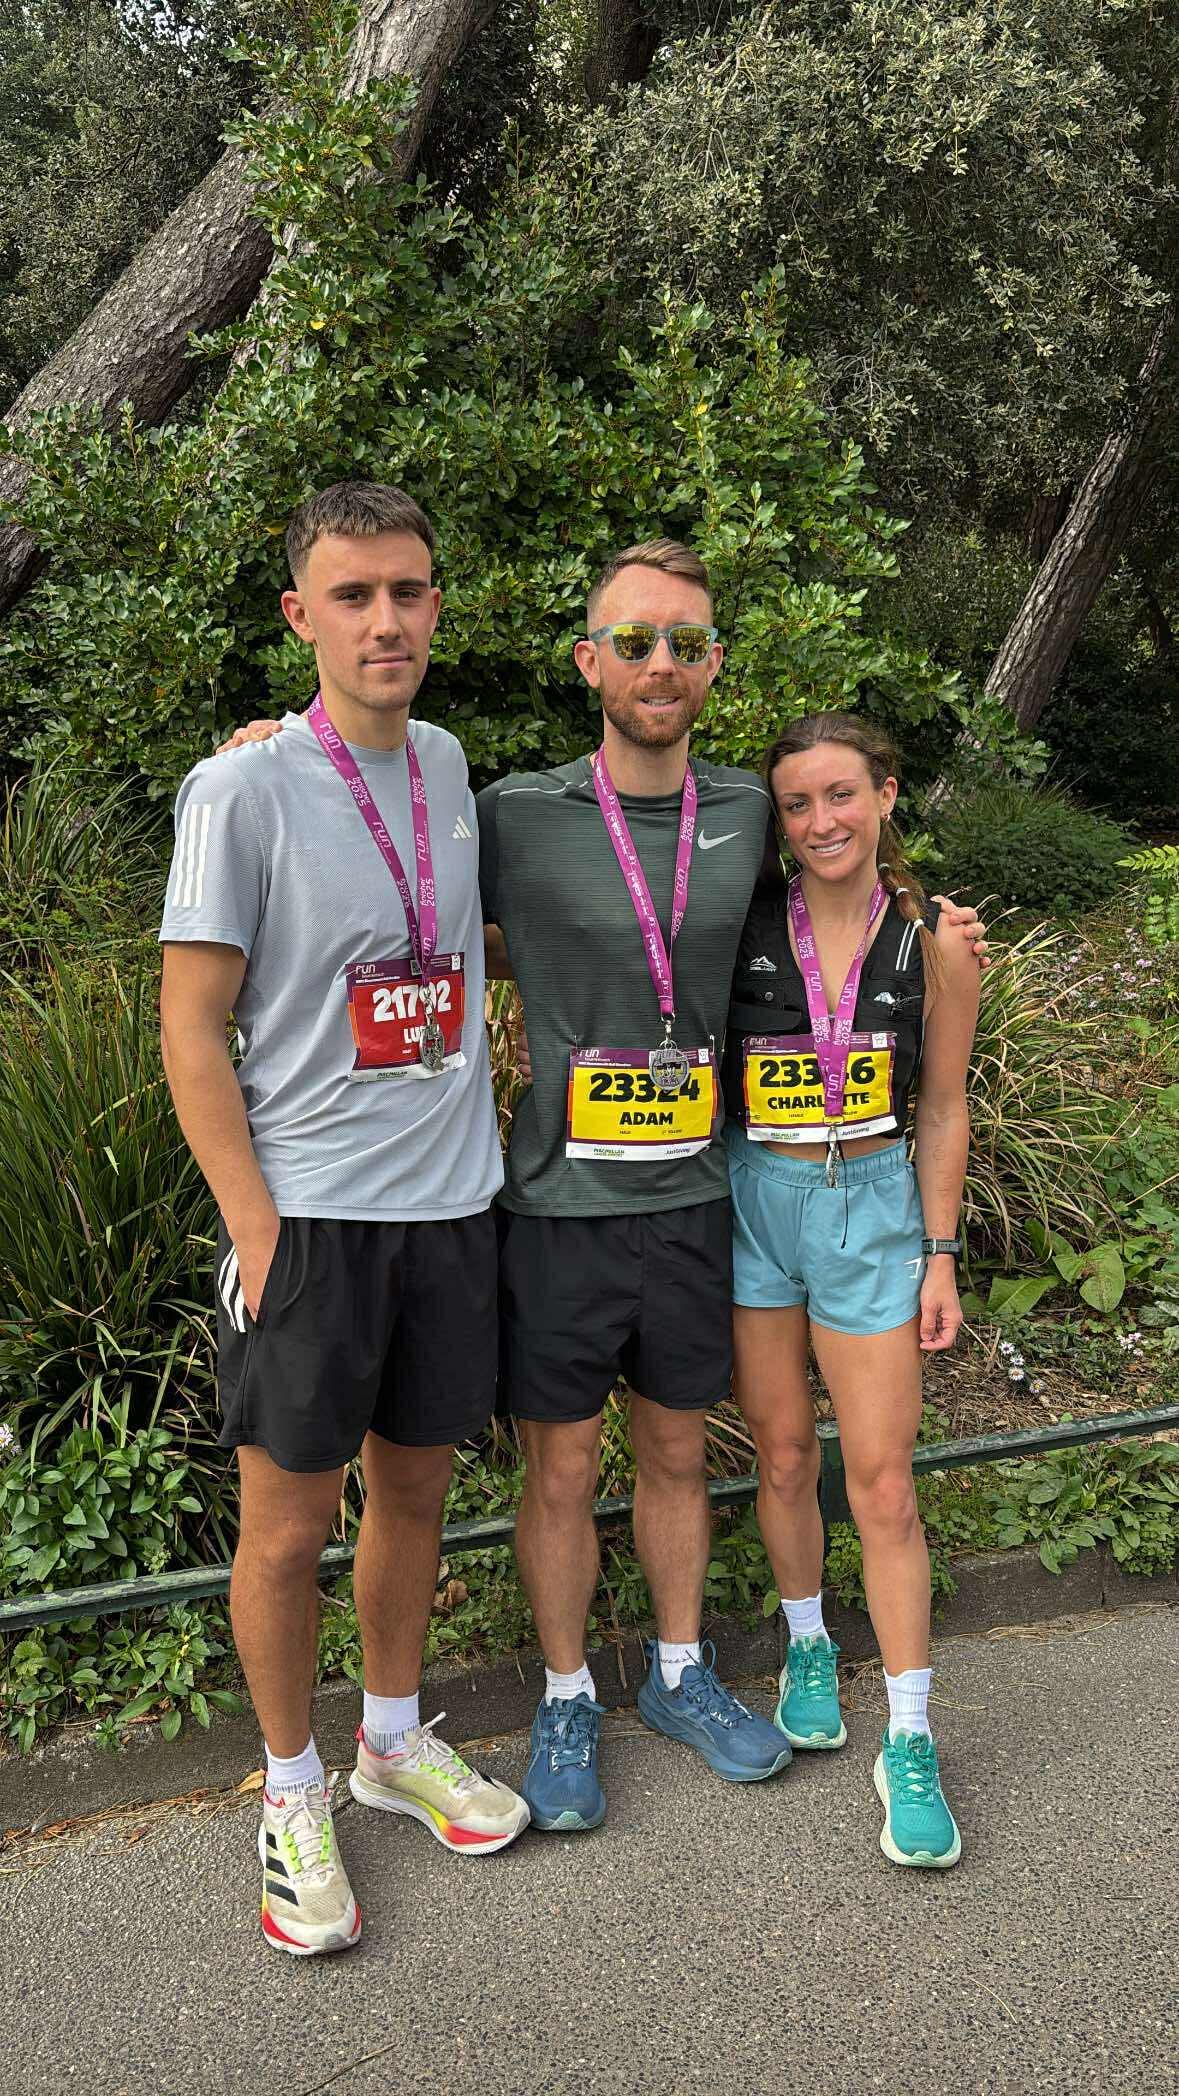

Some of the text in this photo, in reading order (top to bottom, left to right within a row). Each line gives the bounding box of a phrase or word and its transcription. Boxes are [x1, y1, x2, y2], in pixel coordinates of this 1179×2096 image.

[320, 722, 342, 749] run
[347, 777, 367, 806] 2025
[684, 776, 694, 800] run
[373, 822, 392, 848] run
[417, 833, 427, 861] run
[426, 878, 435, 907] 2025
[676, 868, 686, 894] run
[793, 892, 806, 914] run
[797, 937, 809, 959] 2025
[355, 964, 376, 975] run
[809, 971, 822, 992] run
[840, 983, 853, 1005] run
[811, 1018, 824, 1043] 2025
[833, 1019, 842, 1046] finisher
[840, 1019, 852, 1046] 2025
[579, 1049, 600, 1058] run
[759, 1056, 876, 1088] 2336
[827, 1074, 839, 1098] run
[767, 1092, 870, 1110] CHARLTTE
[619, 1112, 674, 1125] ADAM
